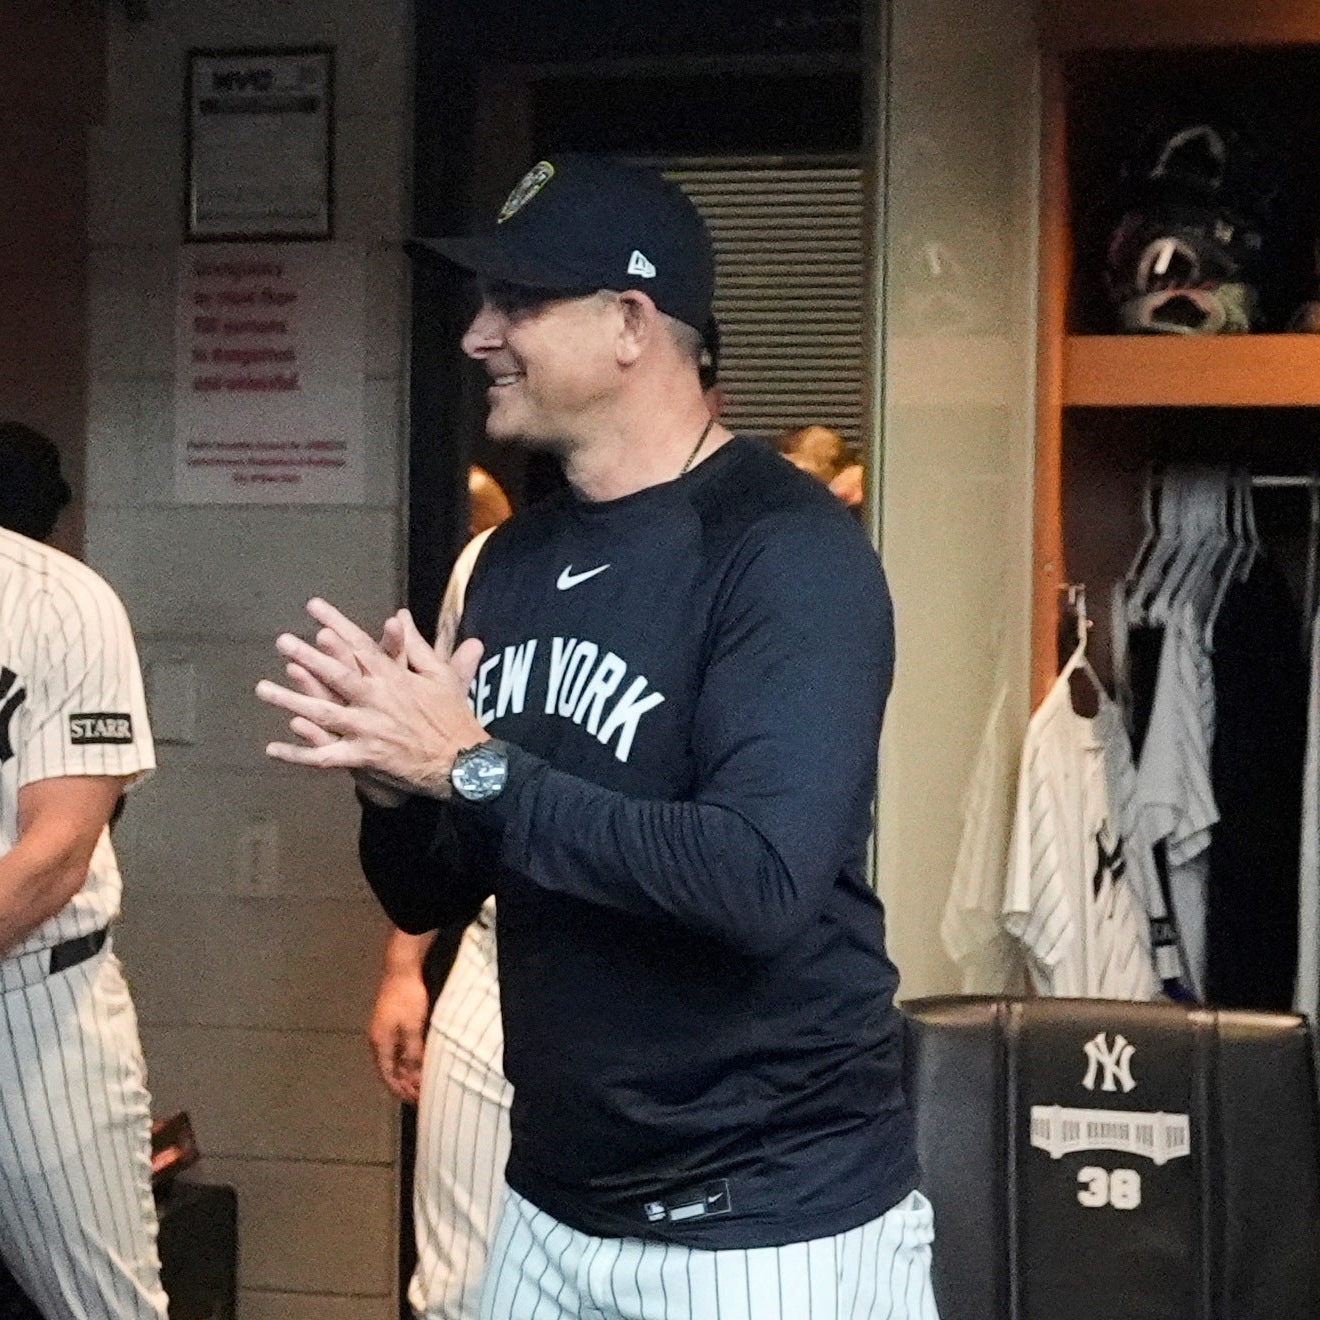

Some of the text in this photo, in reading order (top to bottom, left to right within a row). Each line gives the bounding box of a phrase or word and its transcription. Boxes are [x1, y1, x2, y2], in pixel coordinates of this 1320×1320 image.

[467, 636, 666, 763] EW YORK
[70, 718, 132, 739] STARR
[1082, 1032, 1137, 1093] NY
[1076, 1165, 1142, 1210] 38
